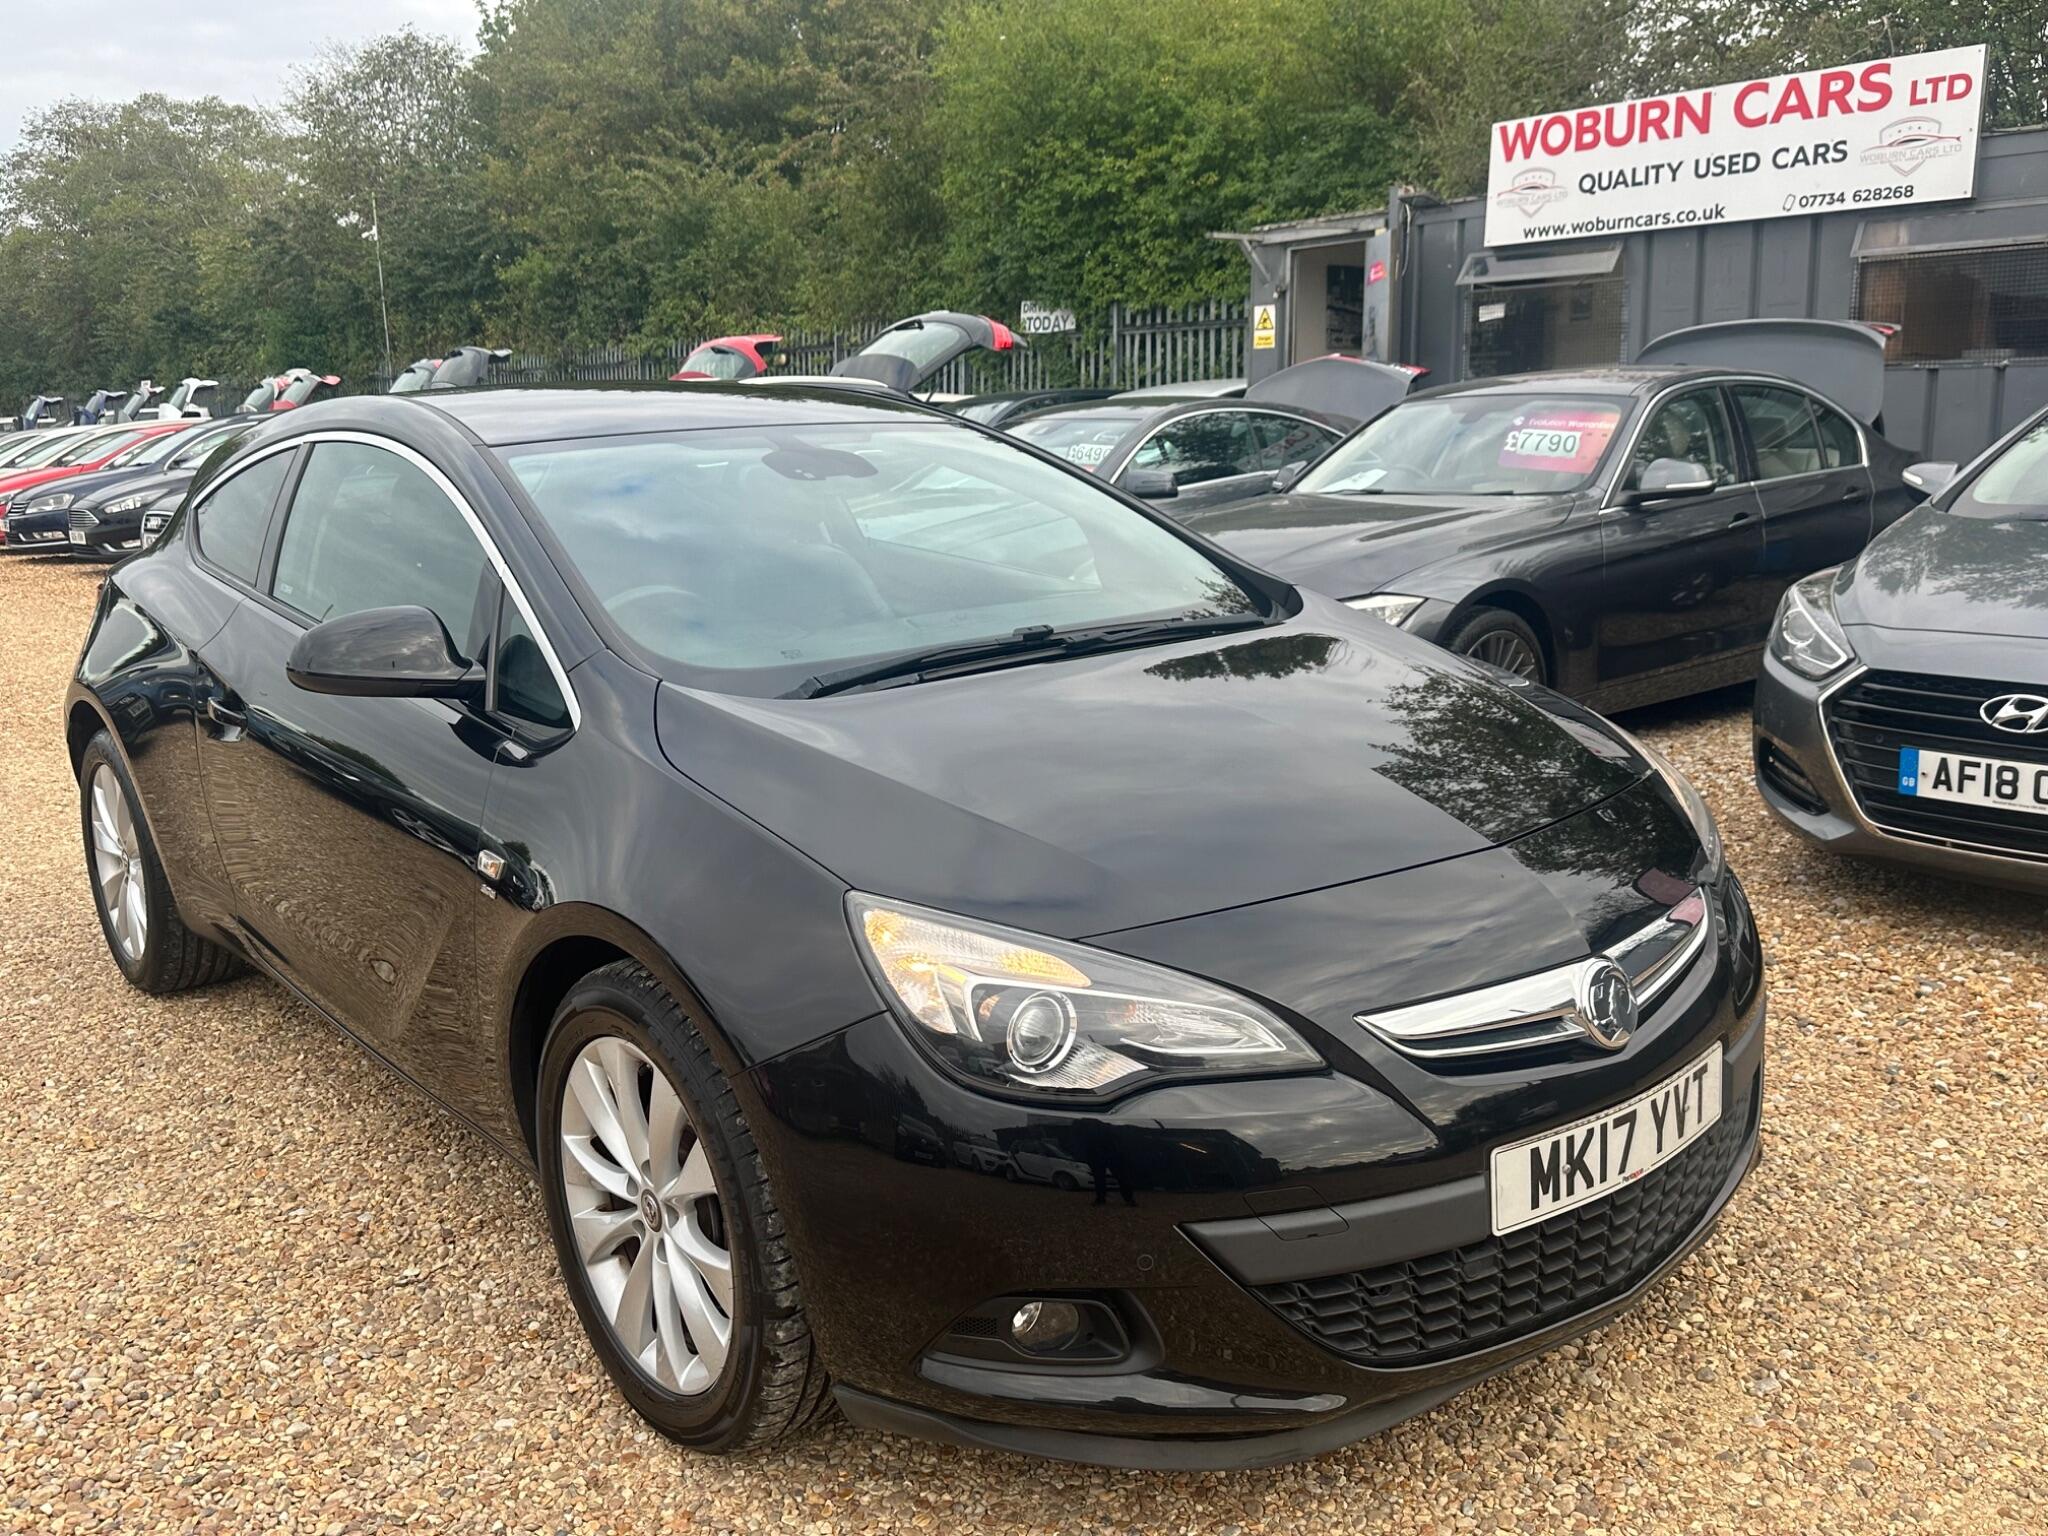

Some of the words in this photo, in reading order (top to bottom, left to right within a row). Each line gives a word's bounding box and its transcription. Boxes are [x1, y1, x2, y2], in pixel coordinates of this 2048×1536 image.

[1500, 91, 1713, 162] WOBURN
[1733, 63, 1893, 128] CARS
[1909, 73, 1973, 106] LTD
[1579, 161, 1684, 195] QUALITY
[1694, 152, 1761, 179] USED
[1772, 140, 1848, 170] CARS
[1860, 151, 1907, 163] WOBURN
[1909, 146, 1940, 157] CARS
[1943, 144, 1963, 153] LTD
[1799, 192, 1846, 208] 07734
[1852, 185, 1914, 203] 628268
[1523, 203, 1726, 239] www.woburncars.co.uk
[1027, 315, 1071, 332] TODAY
[1504, 431, 1577, 454] £7790
[1902, 776, 1915, 787] GB
[1932, 757, 2019, 801] AF18
[1530, 1108, 1638, 1211] MK17
[1650, 1062, 1709, 1155] YVT
